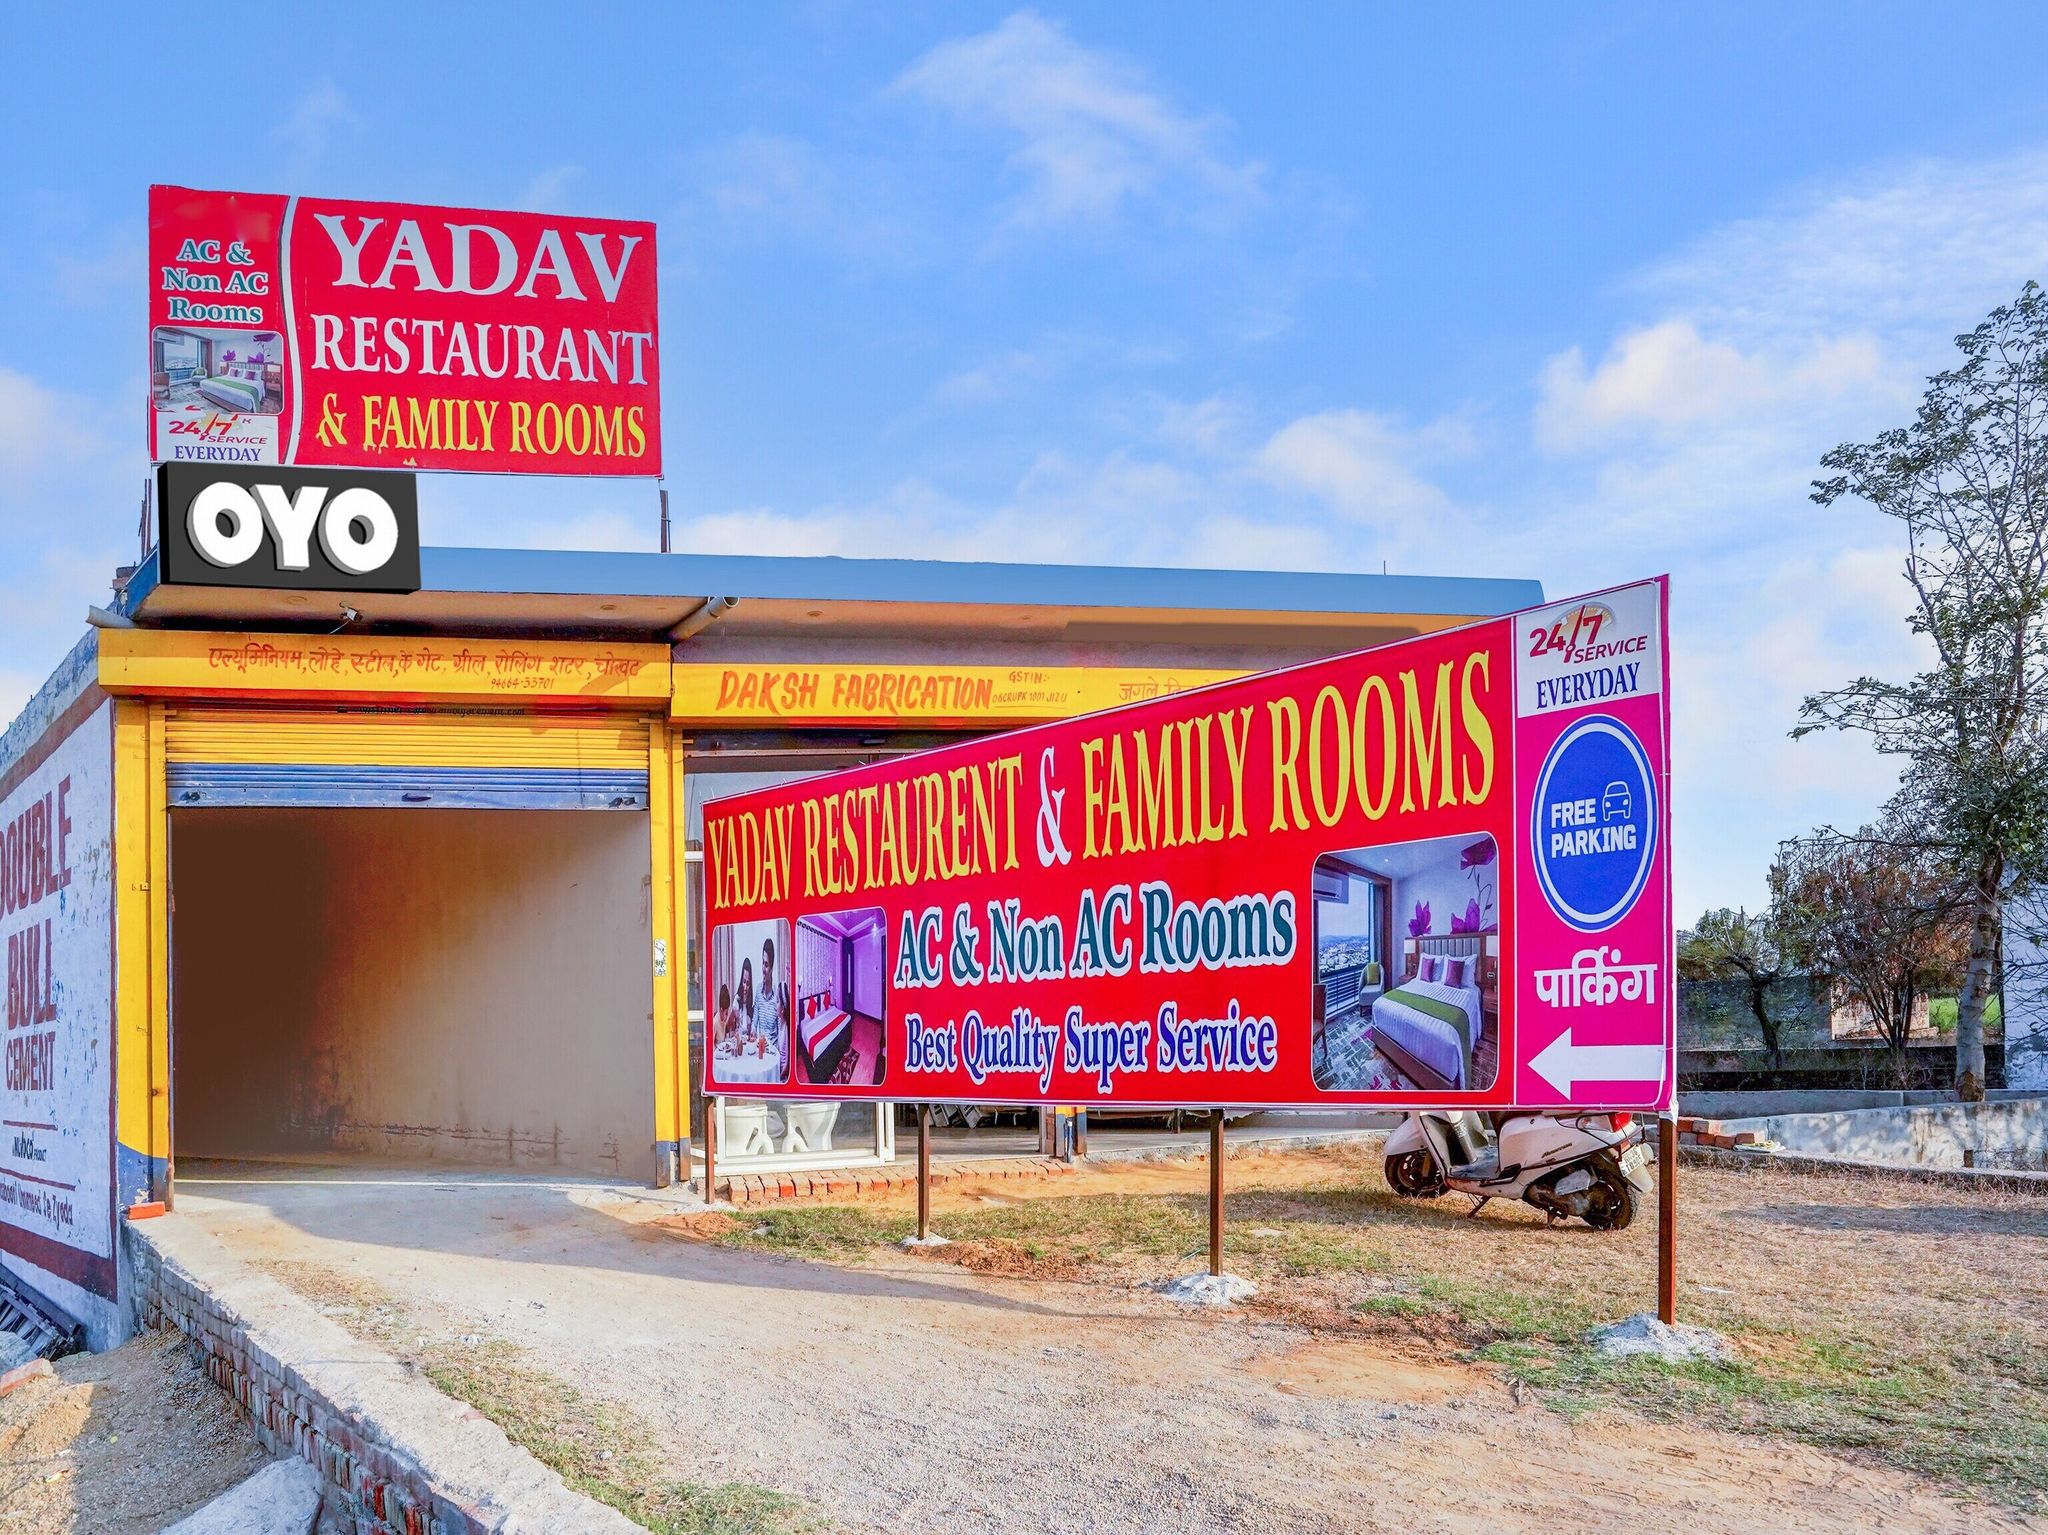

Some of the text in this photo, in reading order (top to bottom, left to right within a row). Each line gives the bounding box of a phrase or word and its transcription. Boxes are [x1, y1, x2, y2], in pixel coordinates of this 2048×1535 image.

[176, 239, 255, 266] AC &
[314, 213, 644, 302] YADAV
[162, 266, 268, 295] Non AC
[169, 298, 262, 324] Rooms
[310, 313, 653, 386] RESTAURANT
[169, 413, 233, 440] 24/7
[208, 435, 268, 445] SERVICE
[316, 393, 646, 458] & FAMILY ROOMS
[175, 446, 261, 461] EVERYDAY
[187, 481, 399, 575] OYO
[1529, 605, 1603, 663] 24/7
[1574, 635, 1648, 664] SERVICE
[715, 669, 994, 714] DAKSH FABRICATION
[1537, 662, 1640, 710] EVERYDAY
[708, 650, 1495, 910] YADAV RESTAURENT & FAMILY ROOMS
[1551, 798, 1597, 829] FREE
[1551, 823, 1637, 860] PARKING
[895, 881, 1295, 988] AC & Non AC Rooms
[8, 918, 57, 1030] BULL
[1533, 944, 1658, 1009] पार्किंग
[6, 1032, 56, 1091] CEMENT
[906, 999, 1278, 1094] Best Quality Super Service
